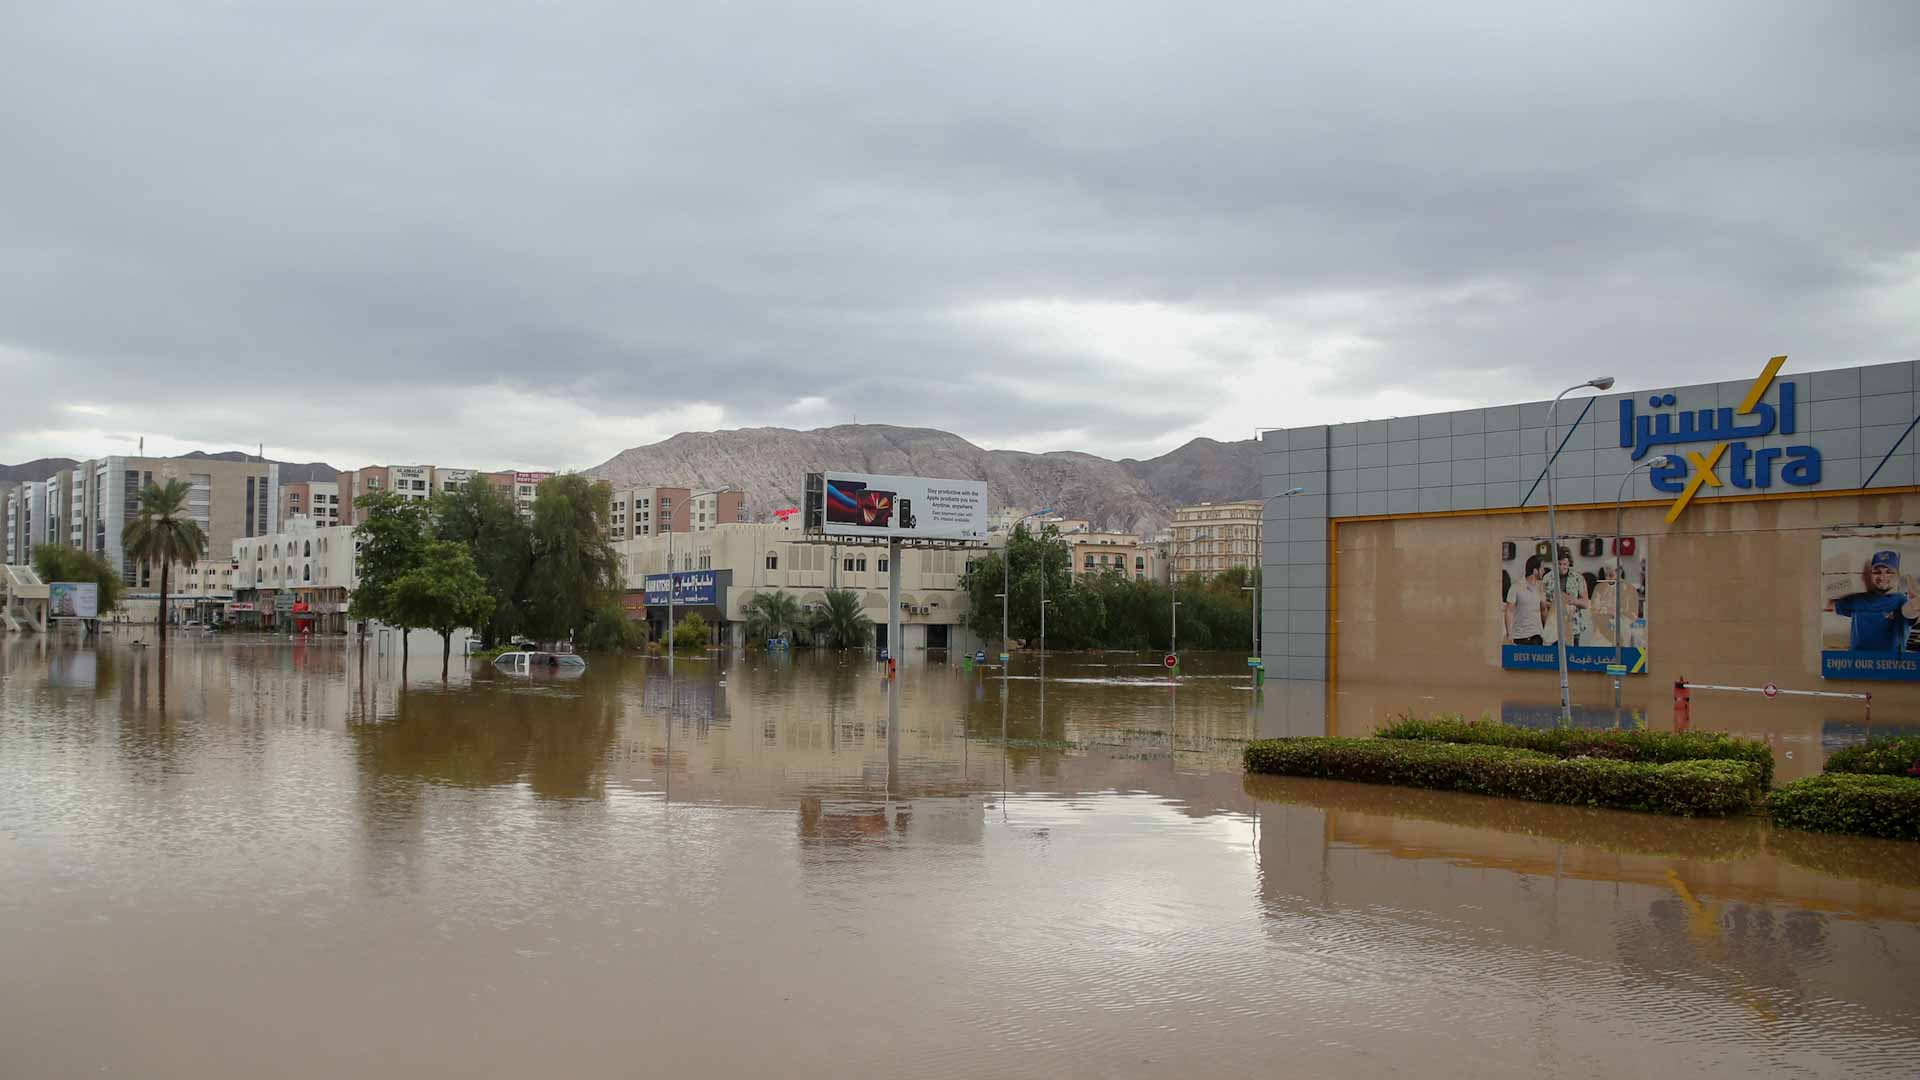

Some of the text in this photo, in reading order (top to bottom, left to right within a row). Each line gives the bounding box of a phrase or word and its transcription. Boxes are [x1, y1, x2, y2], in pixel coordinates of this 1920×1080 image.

[1619, 356, 1796, 461] اكسترا
[1650, 442, 1822, 524] extra
[1513, 652, 1555, 663] BEST VALUE
[1593, 655, 1619, 666] فضل
[1827, 658, 1917, 671] ENJOY OUR SERVICES
